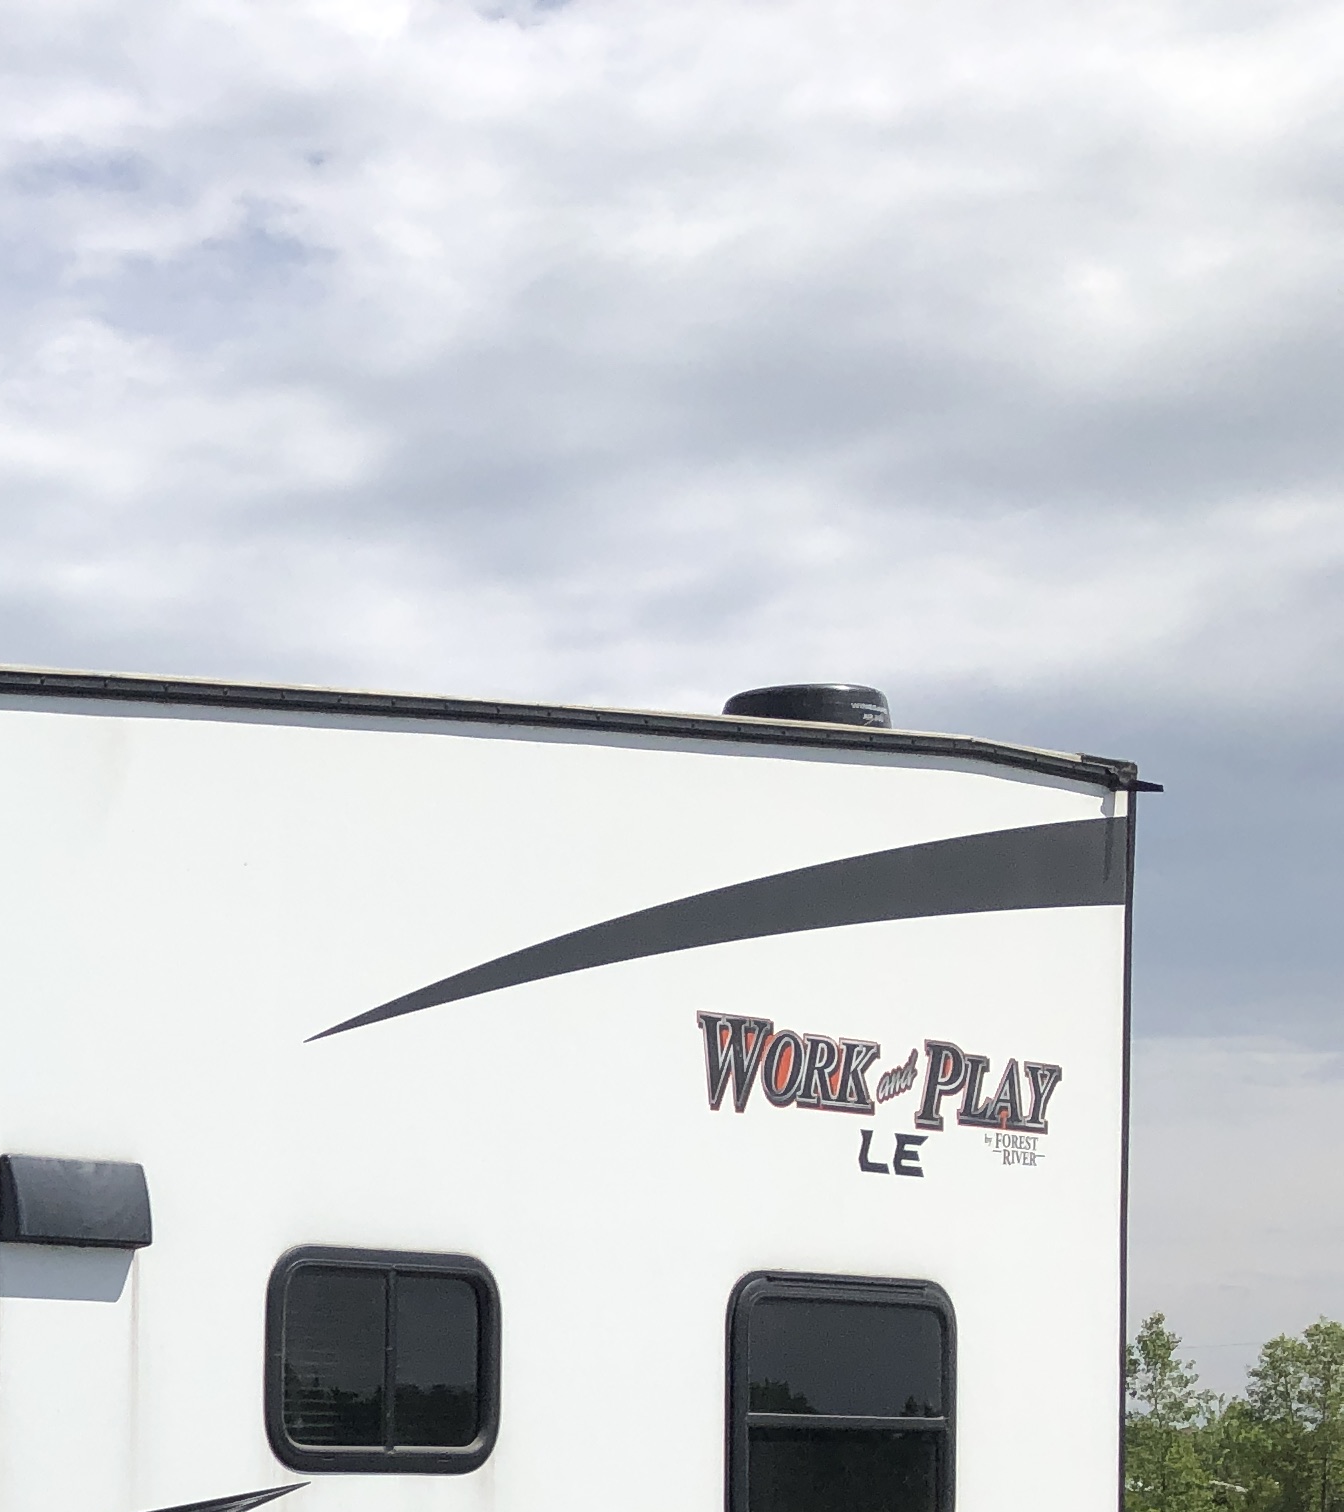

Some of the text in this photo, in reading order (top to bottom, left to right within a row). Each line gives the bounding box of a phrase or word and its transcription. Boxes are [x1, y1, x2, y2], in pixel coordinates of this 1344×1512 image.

[697, 1010, 1062, 1134] WORK and PLAY
[858, 1129, 929, 1177] LE
[995, 1132, 1039, 1151] FOREST
[1002, 1149, 1038, 1166] RIVER
